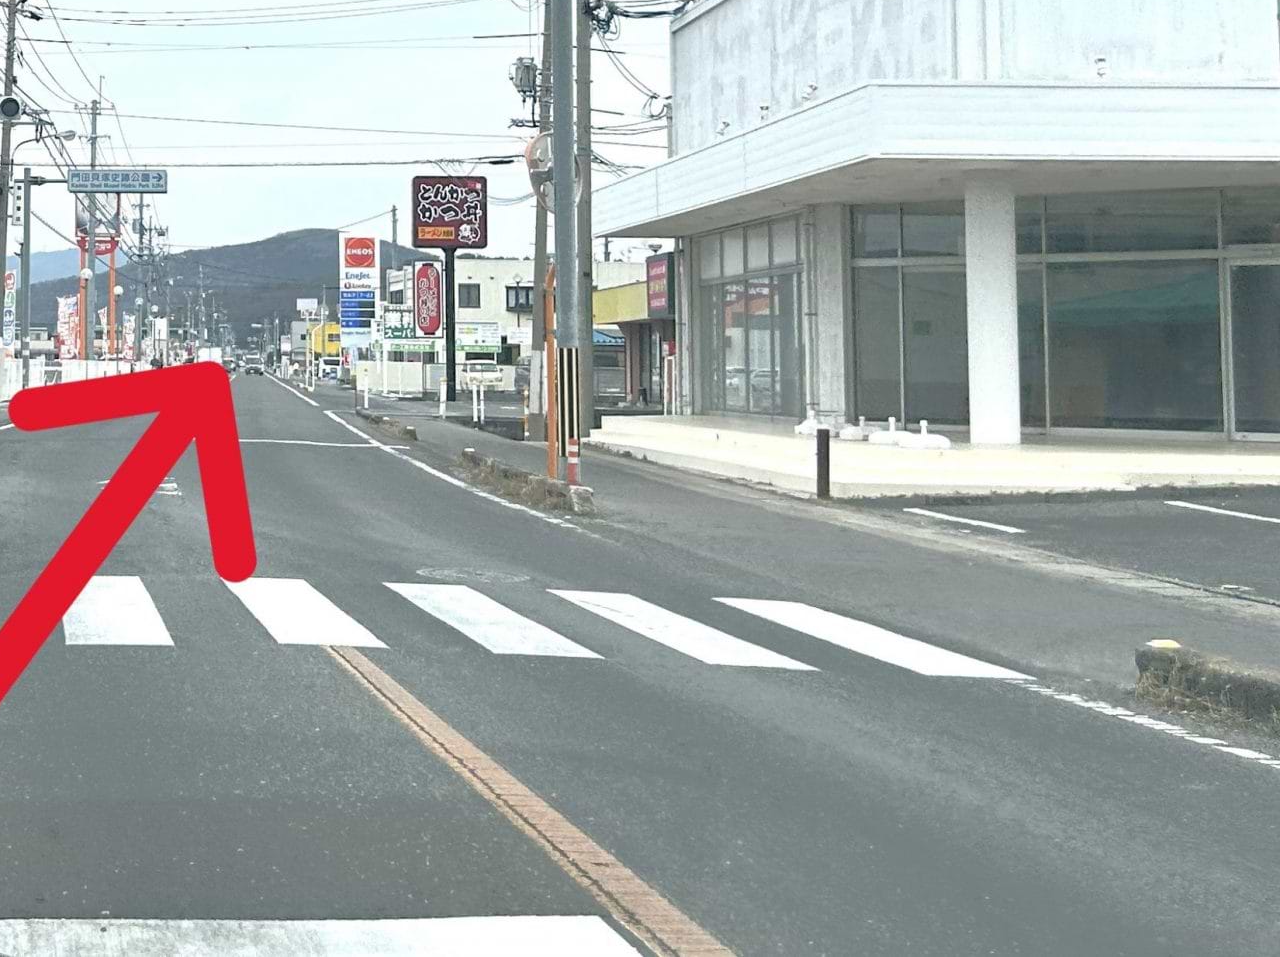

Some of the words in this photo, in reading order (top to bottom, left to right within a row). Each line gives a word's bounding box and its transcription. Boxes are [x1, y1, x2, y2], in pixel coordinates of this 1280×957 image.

[419, 184, 481, 202] とんかつ
[418, 202, 482, 223] かつ丼
